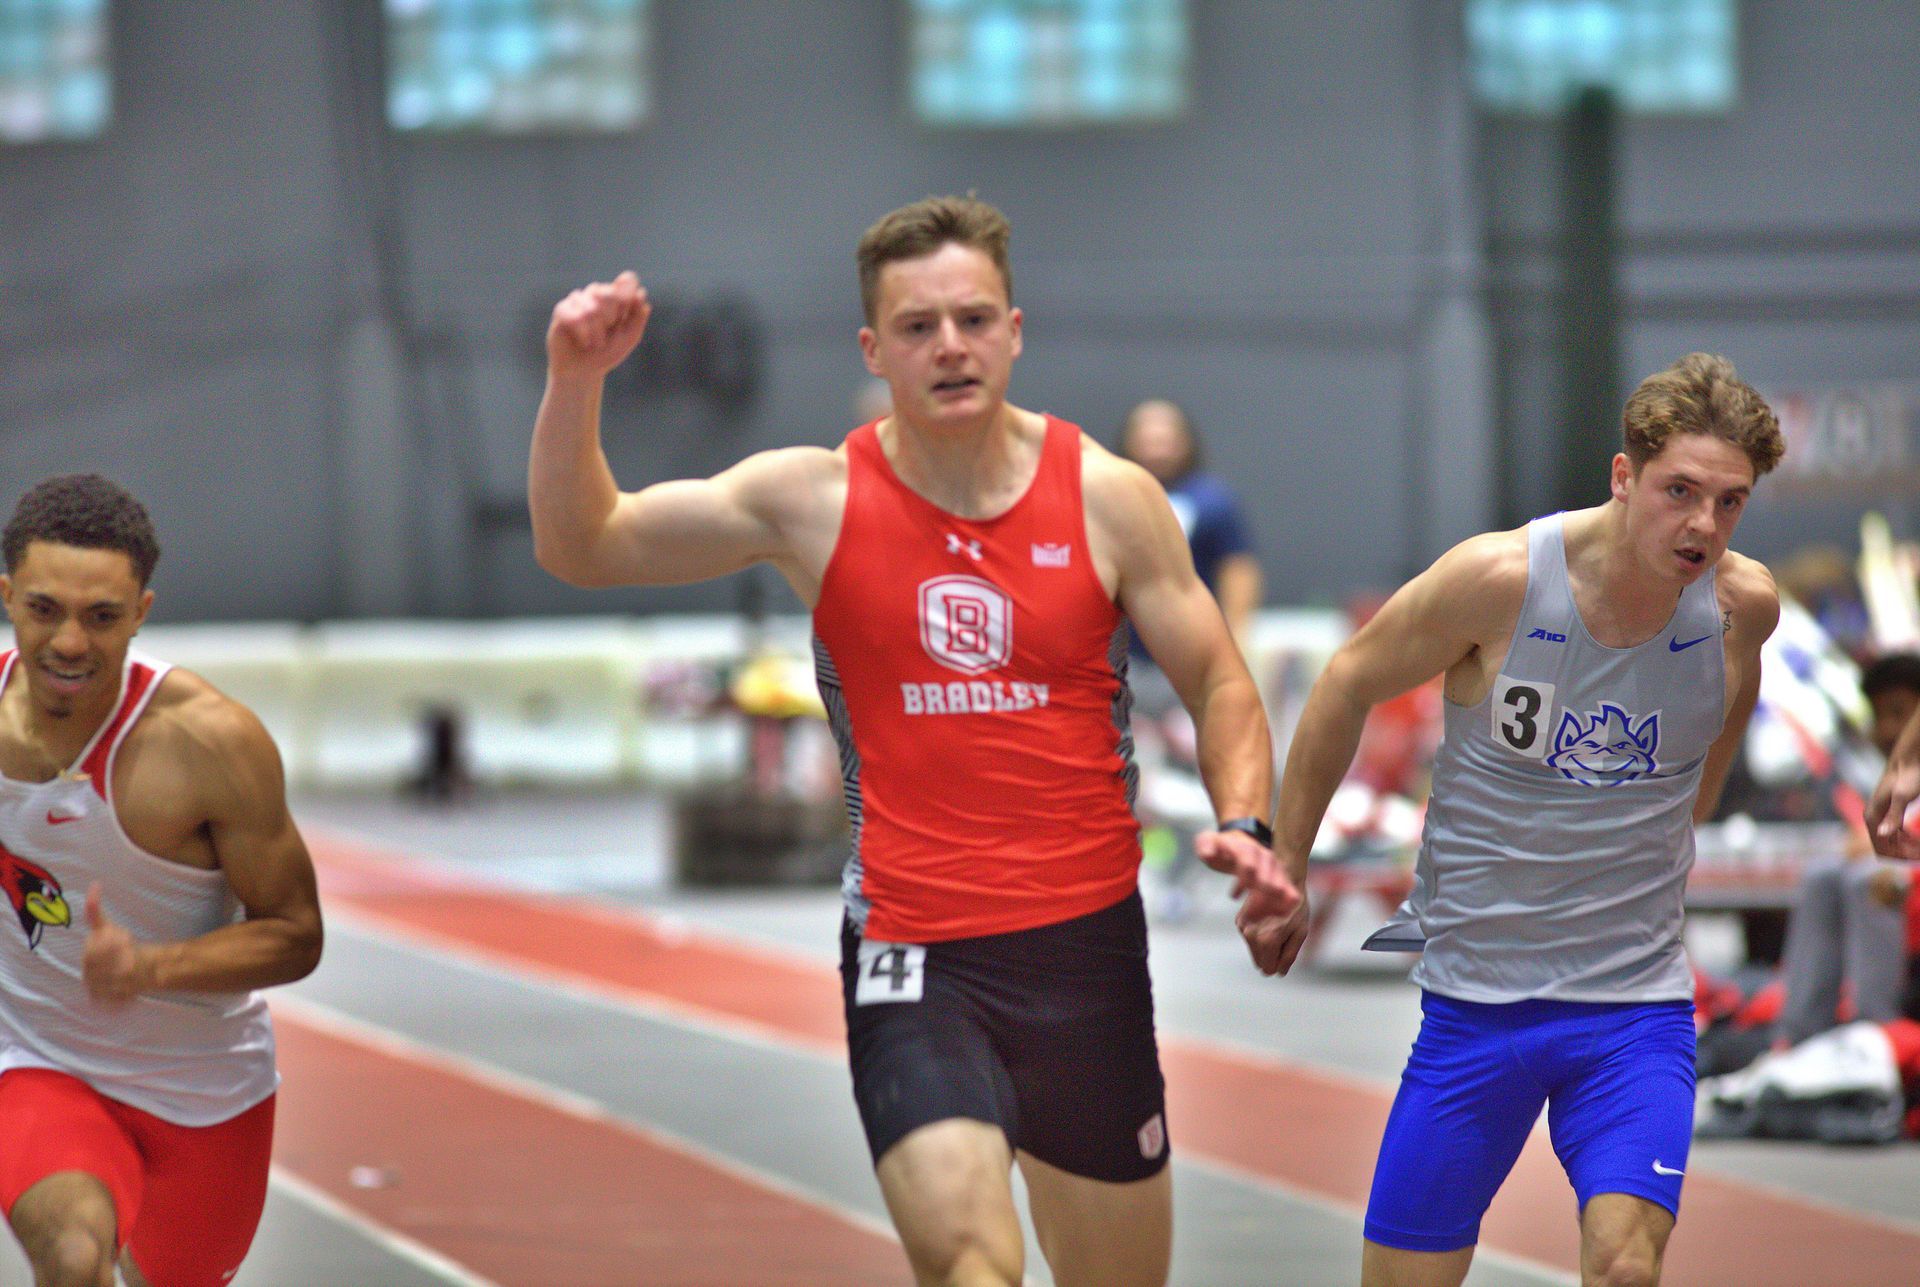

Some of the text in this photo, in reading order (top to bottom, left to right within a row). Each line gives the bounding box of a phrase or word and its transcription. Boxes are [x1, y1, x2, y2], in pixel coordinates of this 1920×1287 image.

[942, 594, 987, 654] B
[1527, 627, 1566, 643] A10
[901, 680, 1050, 715] BRADLEY
[1501, 685, 1541, 750] 3
[869, 946, 911, 991] 4
